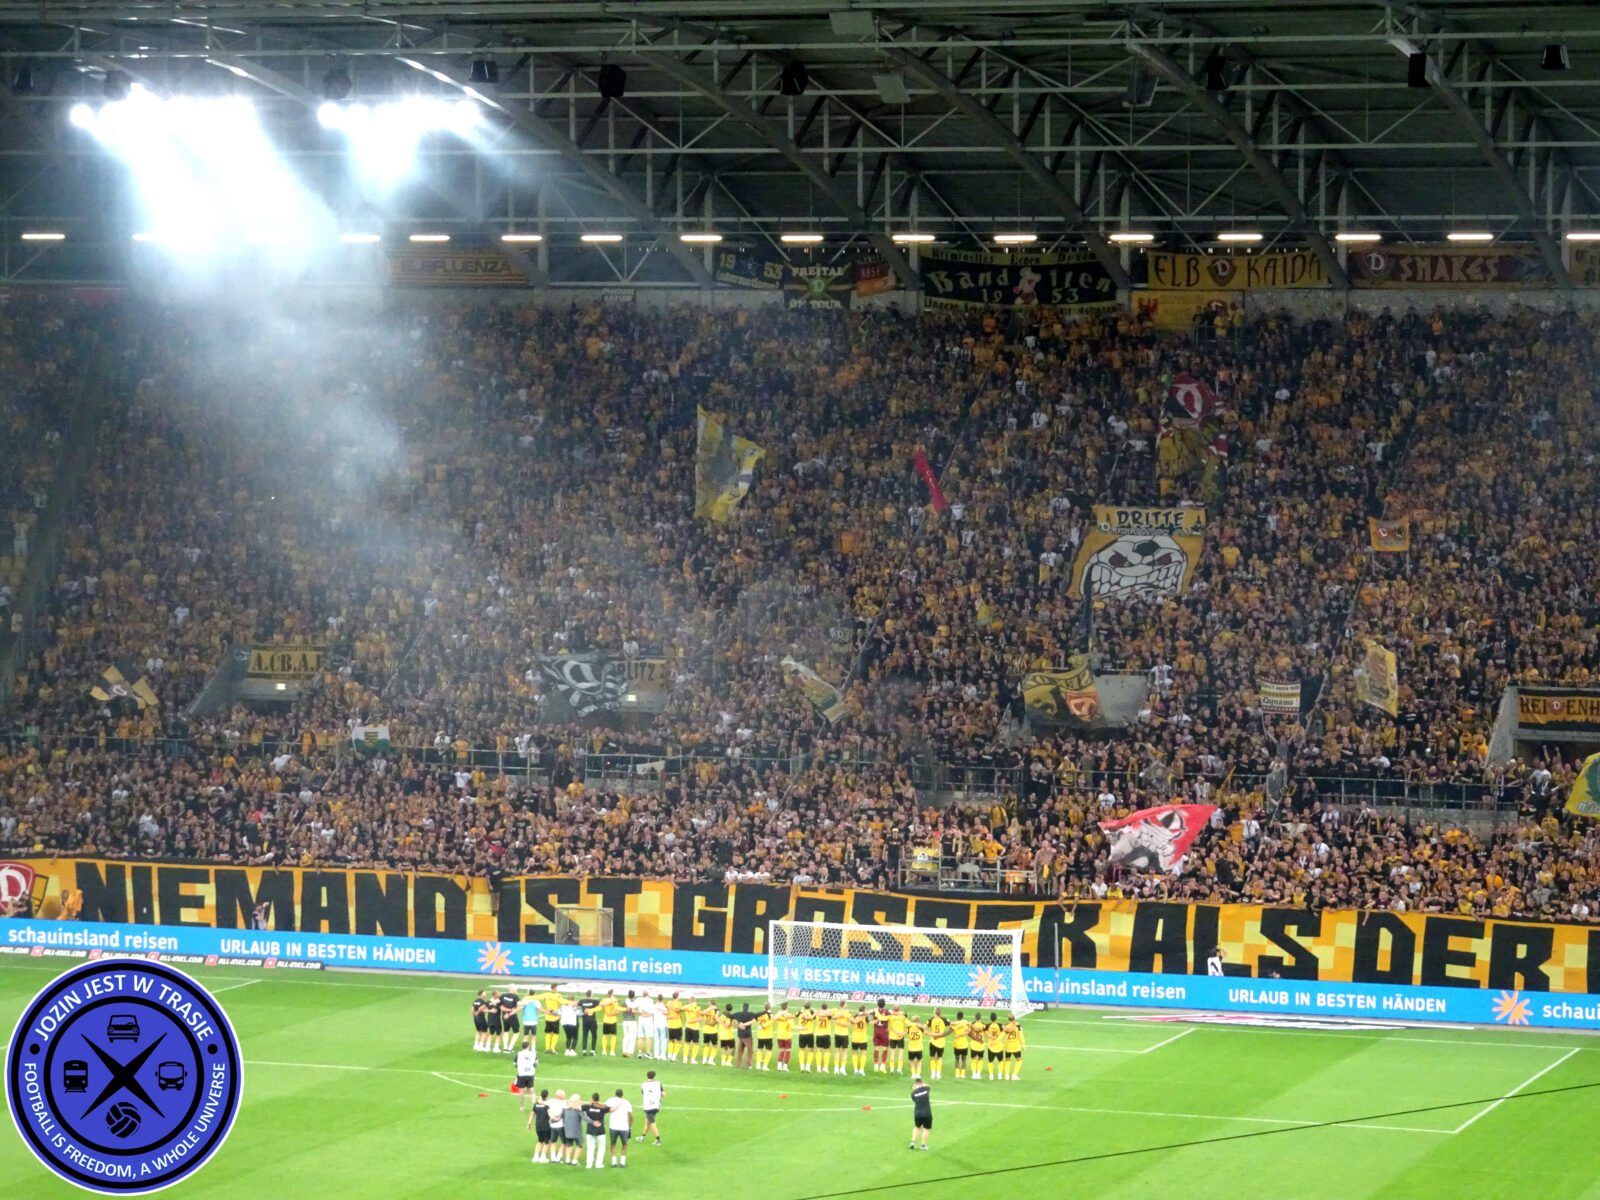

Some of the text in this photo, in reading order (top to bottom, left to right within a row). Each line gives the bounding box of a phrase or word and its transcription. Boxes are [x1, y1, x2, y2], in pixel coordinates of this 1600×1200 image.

[792, 265, 844, 276] FREITAL
[1154, 256, 1200, 287] ELB
[1400, 255, 1499, 282] SNAKES
[1116, 509, 1184, 528] DRITTE
[8, 927, 178, 950] schauinsland reisen
[76, 861, 467, 941] NIEMAND
[498, 877, 642, 948] IST
[673, 881, 1102, 968] GRÖSSER
[1129, 902, 1322, 981] ALS
[1352, 910, 1554, 993] DER
[220, 938, 436, 964] URLAUB IN BESTEN HÄNDEN
[522, 953, 682, 975] schauinsland reisen
[804, 968, 860, 983] BESTEN
[865, 968, 926, 987] HÄNDEN
[1024, 976, 1186, 999] chauinsland reisen
[1228, 989, 1446, 1012] URLAUB IN BESTEN HÄNDEN
[1543, 1002, 1600, 1020] schaui
[911, 1032, 921, 1041] 25
